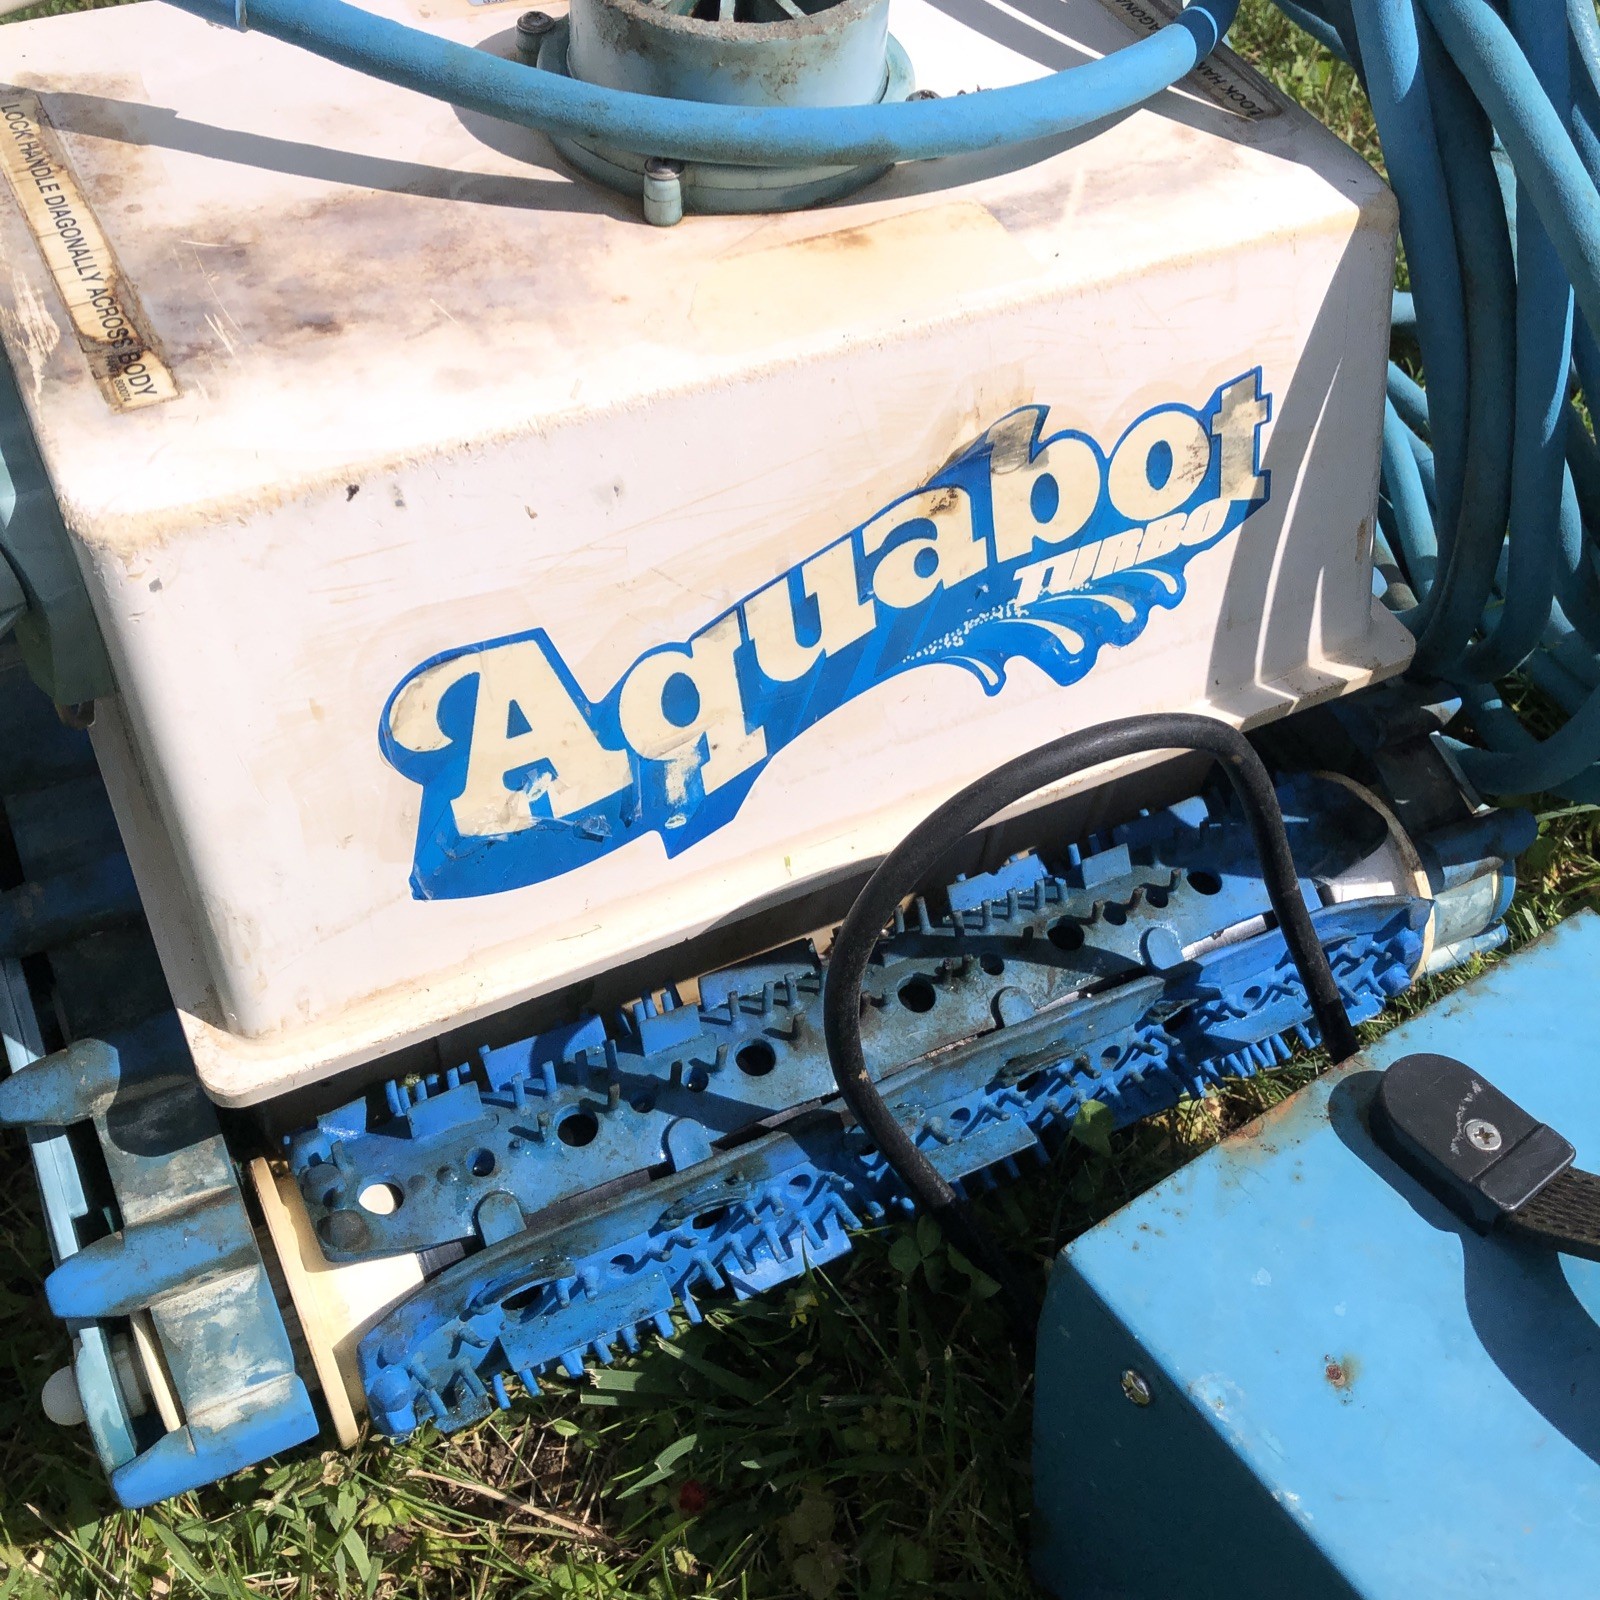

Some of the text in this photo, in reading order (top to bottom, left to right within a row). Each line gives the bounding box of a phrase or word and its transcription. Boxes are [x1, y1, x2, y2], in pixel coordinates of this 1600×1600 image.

[1220, 84, 1265, 117] LOCK
[1, 103, 158, 395] LOCK HANDLE DIAGONALLY ACROSS BODY
[387, 370, 1268, 836] Aquabot
[1012, 498, 1231, 607] TURBO
